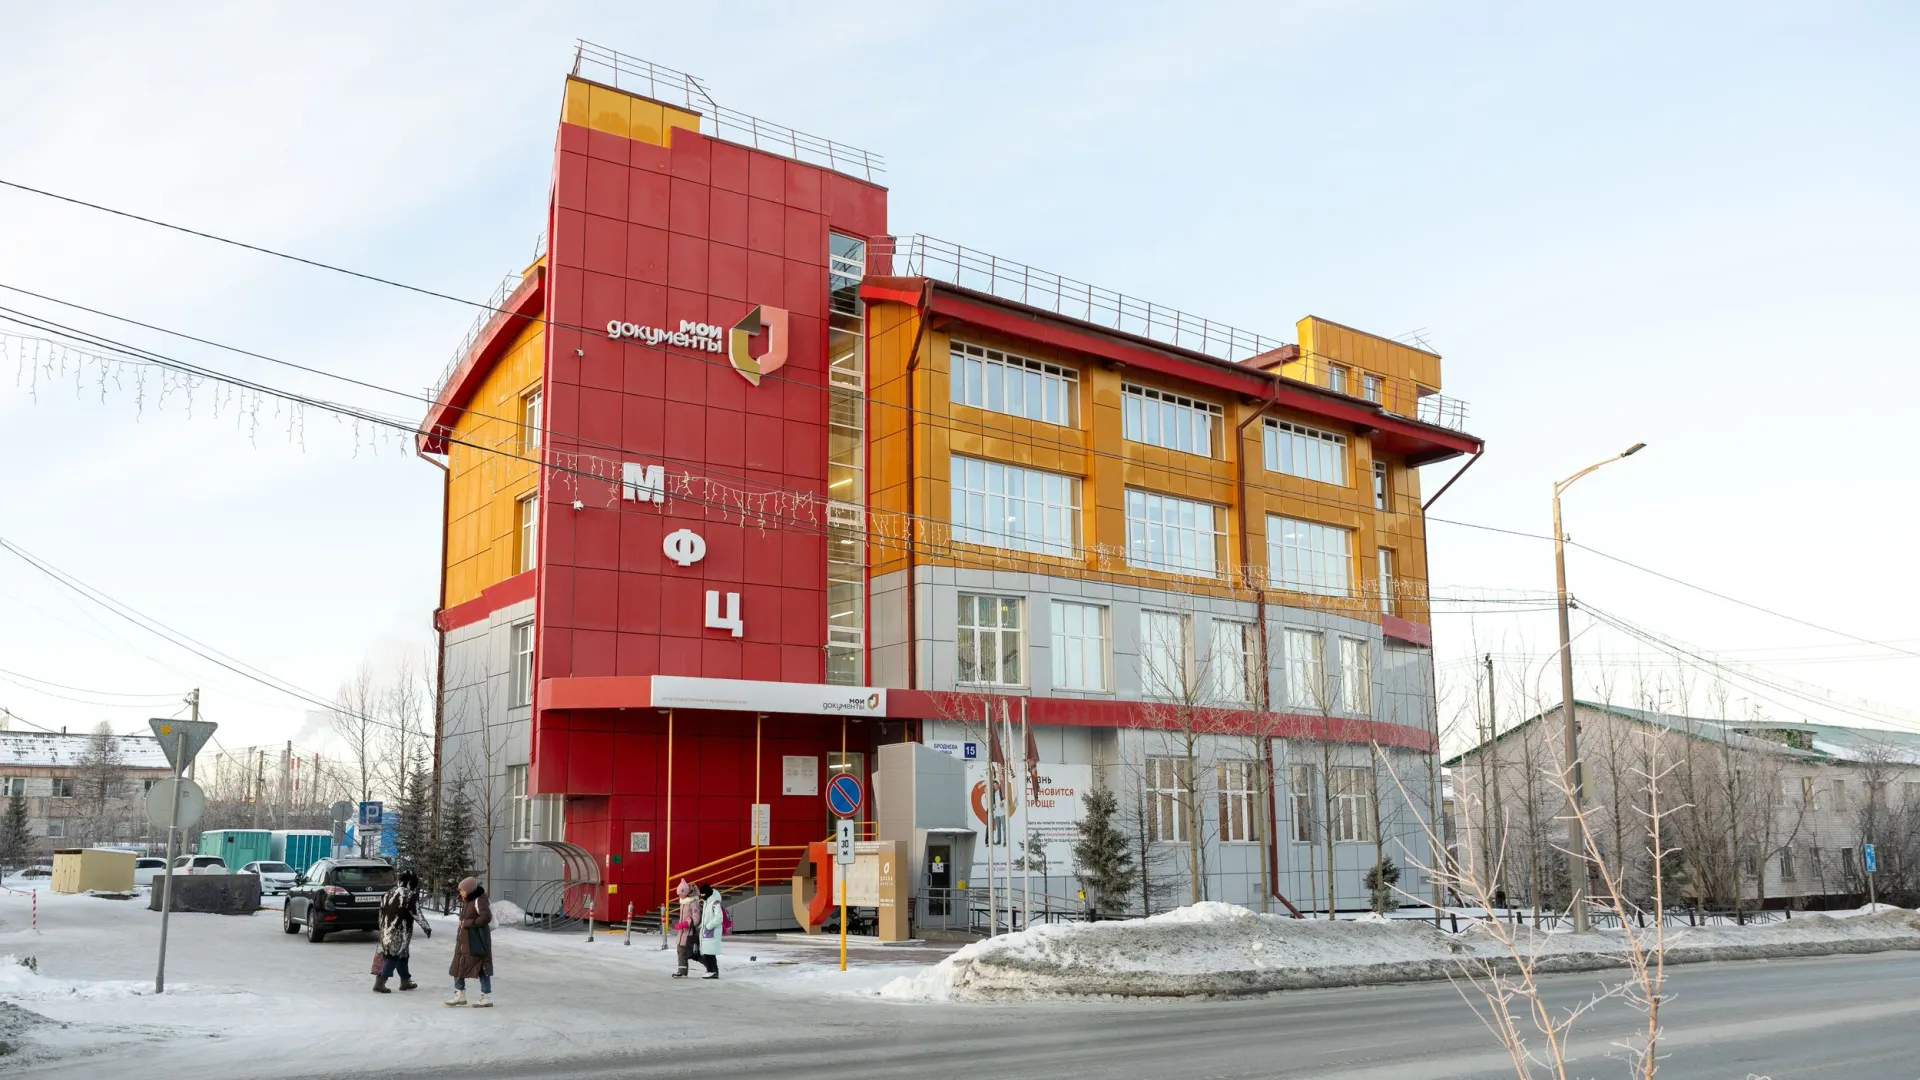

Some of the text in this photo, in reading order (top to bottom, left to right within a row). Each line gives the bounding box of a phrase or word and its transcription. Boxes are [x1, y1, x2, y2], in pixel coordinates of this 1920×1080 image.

[680, 319, 722, 340] мои
[606, 320, 722, 353] документы
[822, 702, 865, 711] документы
[965, 746, 975, 755] 15
[841, 840, 849, 848] 30
